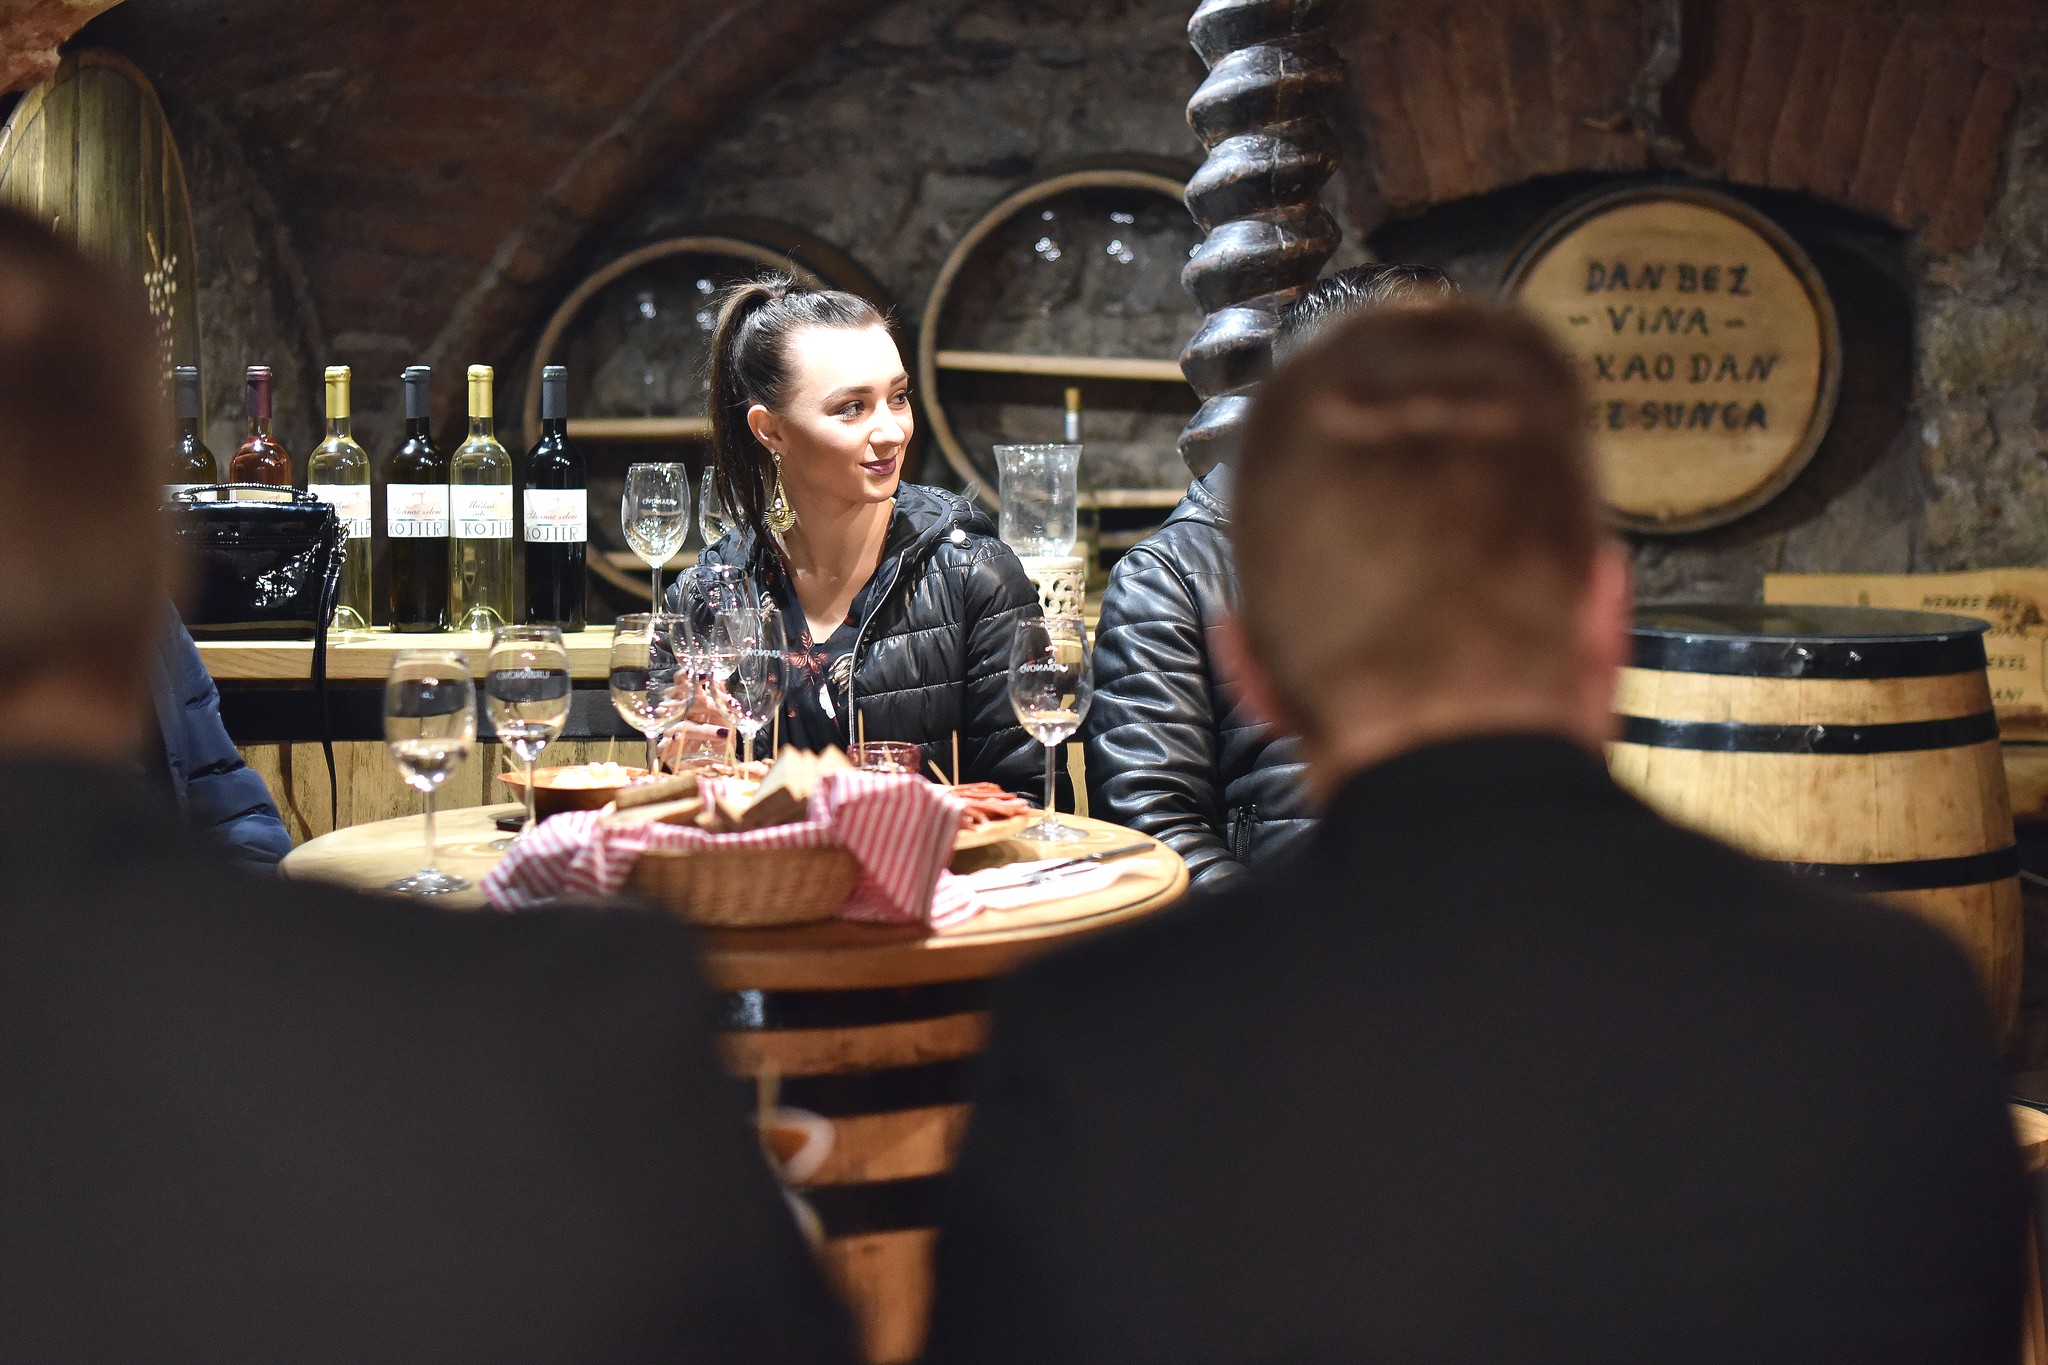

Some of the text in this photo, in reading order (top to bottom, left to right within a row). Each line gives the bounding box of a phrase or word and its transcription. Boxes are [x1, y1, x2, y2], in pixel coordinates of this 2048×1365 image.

[1586, 261, 1750, 296] DAN BEZ
[1595, 352, 1779, 384] KAO DAN
[1640, 401, 1767, 430] SUNCA
[389, 521, 443, 536] KOJTER
[526, 526, 579, 541] KOJTER
